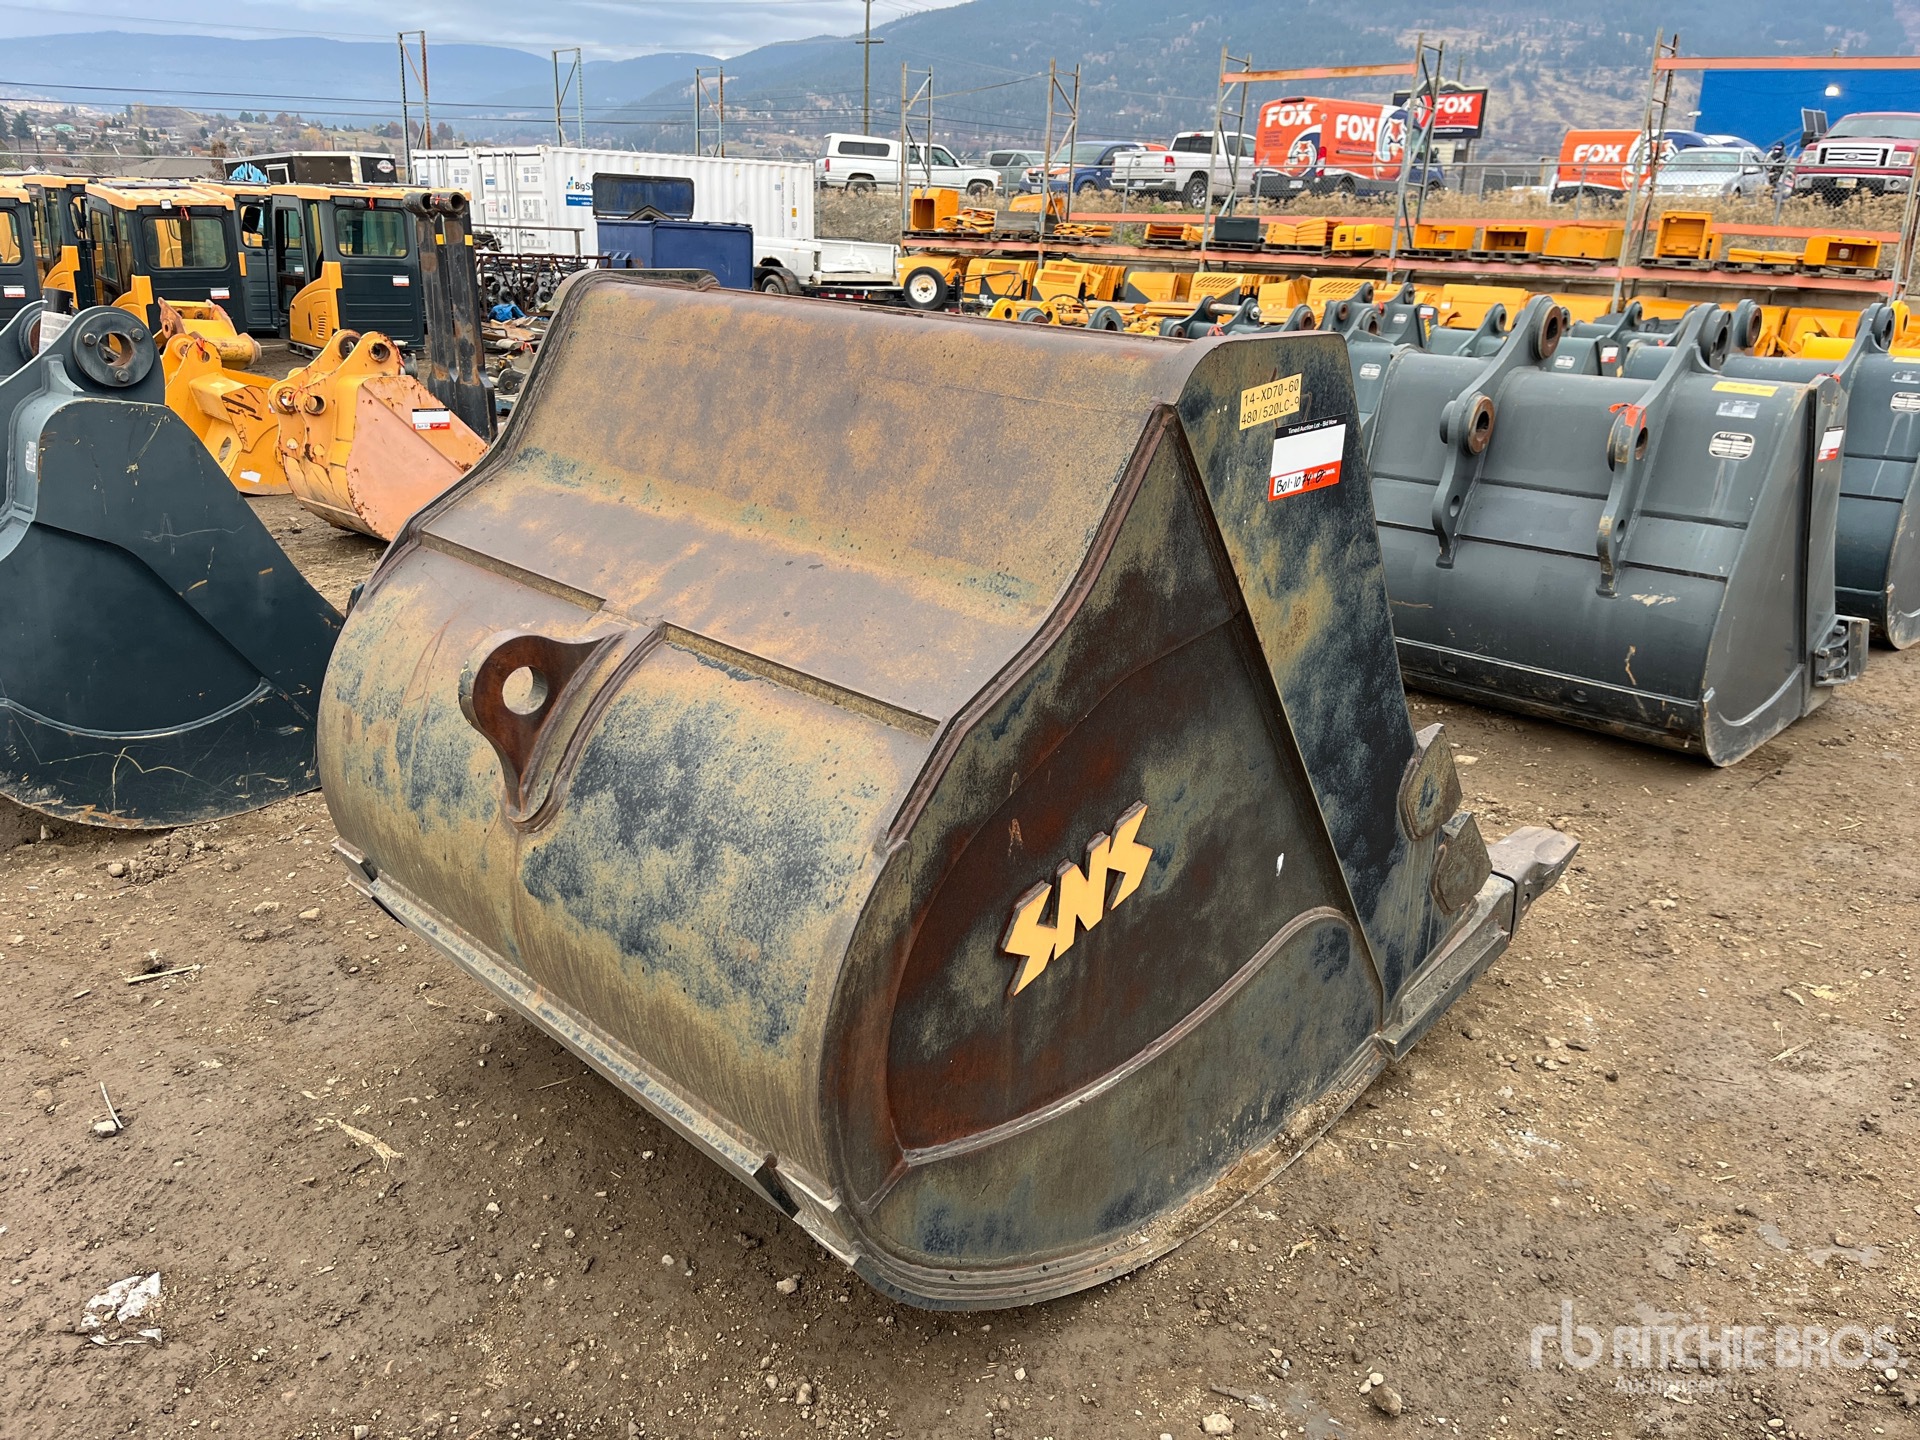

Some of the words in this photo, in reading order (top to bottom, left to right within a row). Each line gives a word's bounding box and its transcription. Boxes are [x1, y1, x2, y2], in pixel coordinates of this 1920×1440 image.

[1265, 103, 1317, 128] FOX
[1435, 95, 1475, 114] FOX
[1335, 113, 1377, 142] FOX
[1573, 144, 1625, 163] FOX
[1244, 378, 1300, 407] 14-XD70-60
[1300, 424, 1313, 432] Auction
[1002, 801, 1153, 997] SNS
